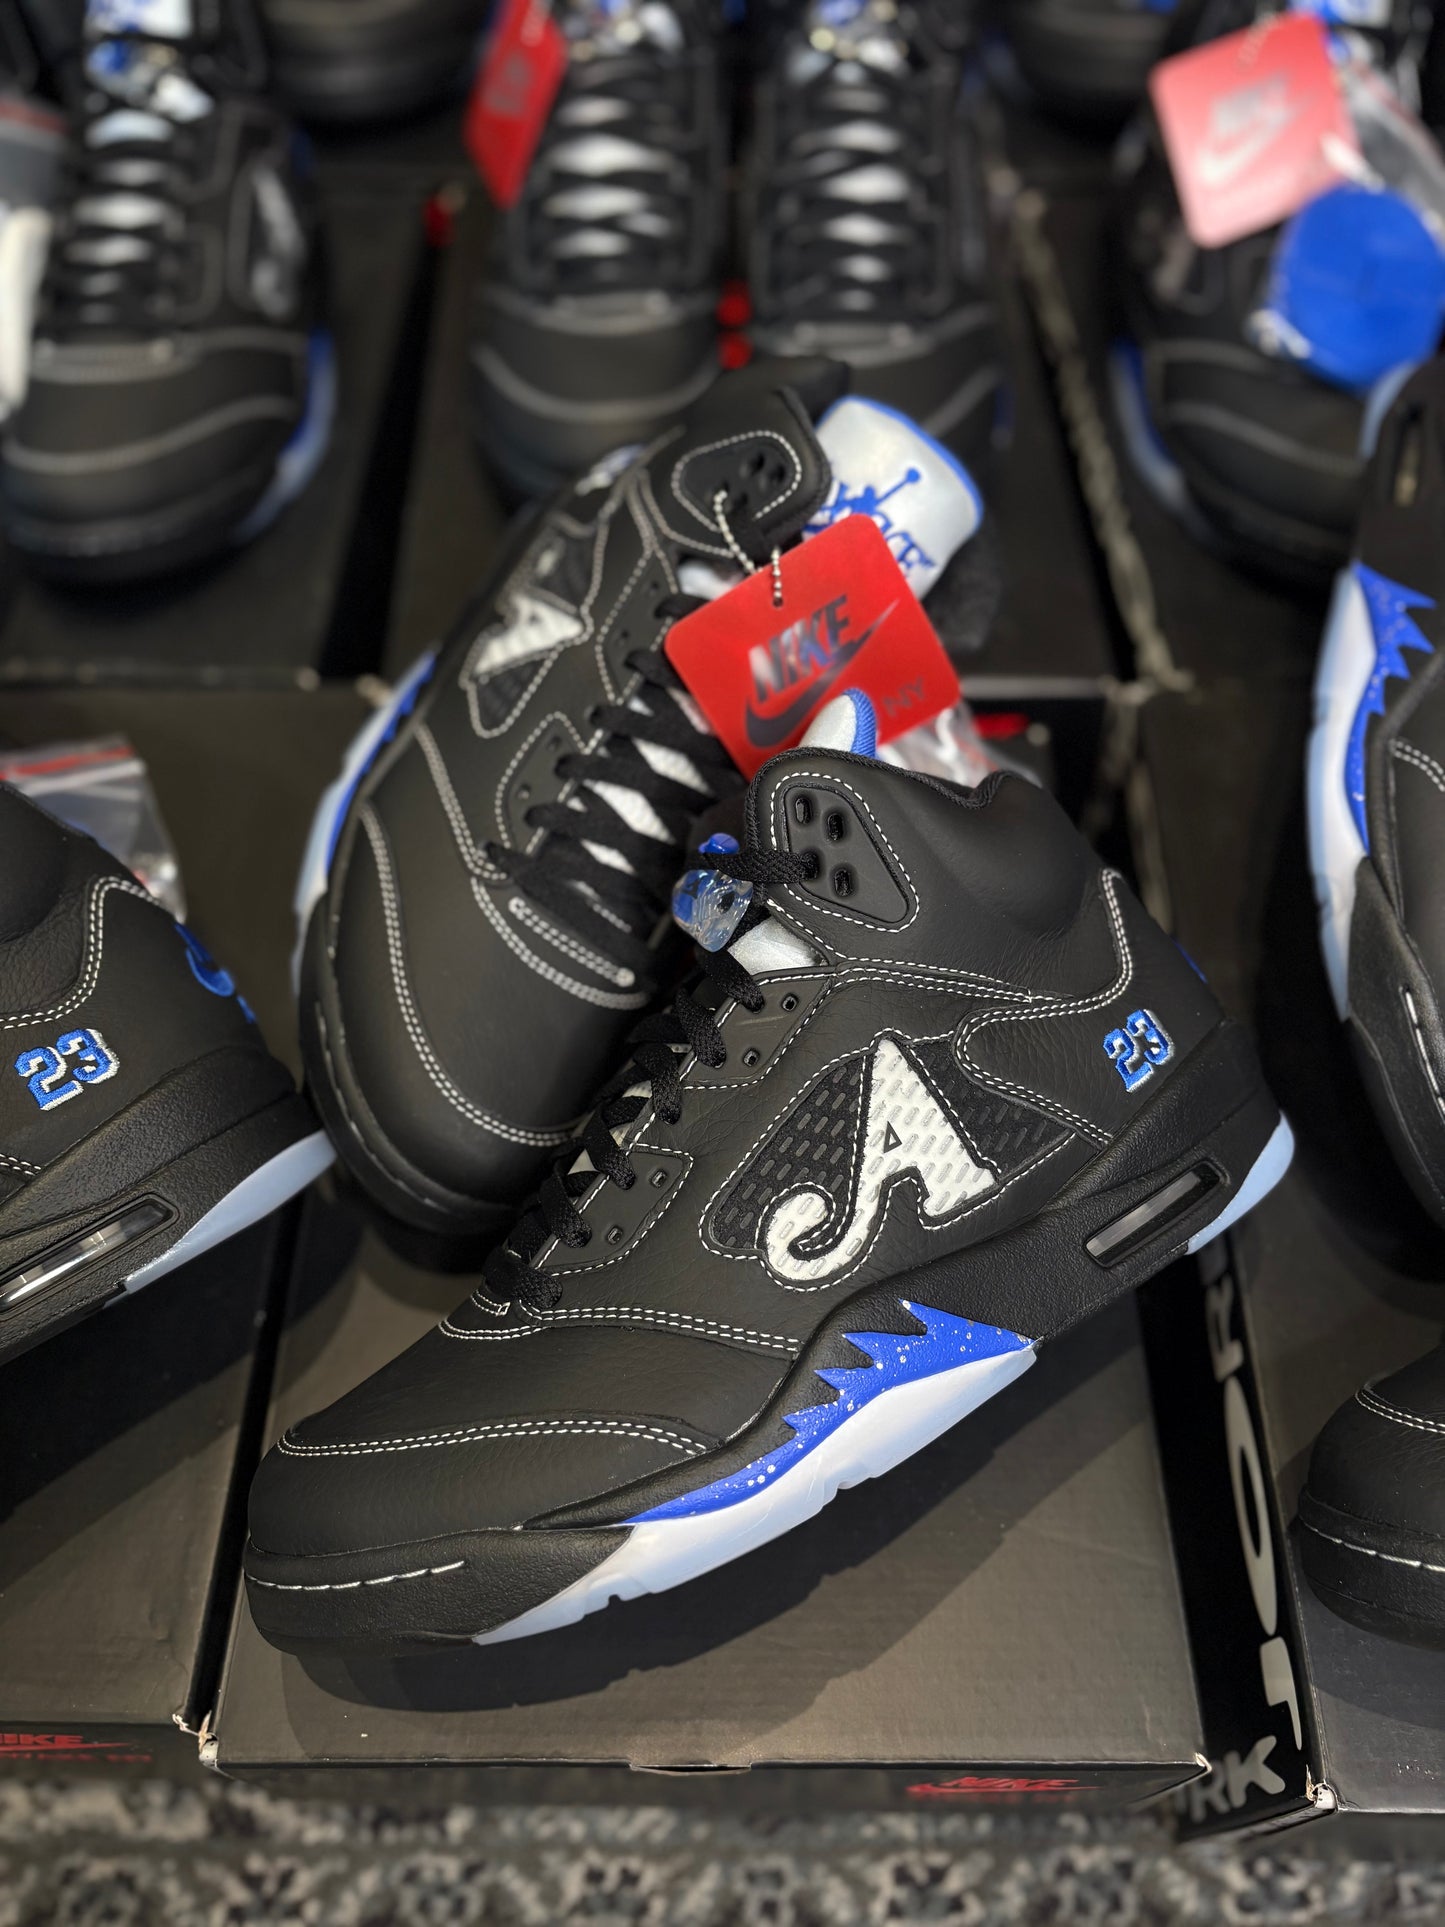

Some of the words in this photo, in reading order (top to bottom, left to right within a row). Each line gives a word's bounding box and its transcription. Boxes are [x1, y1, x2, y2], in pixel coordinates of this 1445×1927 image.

[748, 594, 849, 703] NIKE
[14, 1028, 120, 1111] 23
[1103, 1009, 1175, 1092] 23
[0, 1733, 84, 1745] IKE
